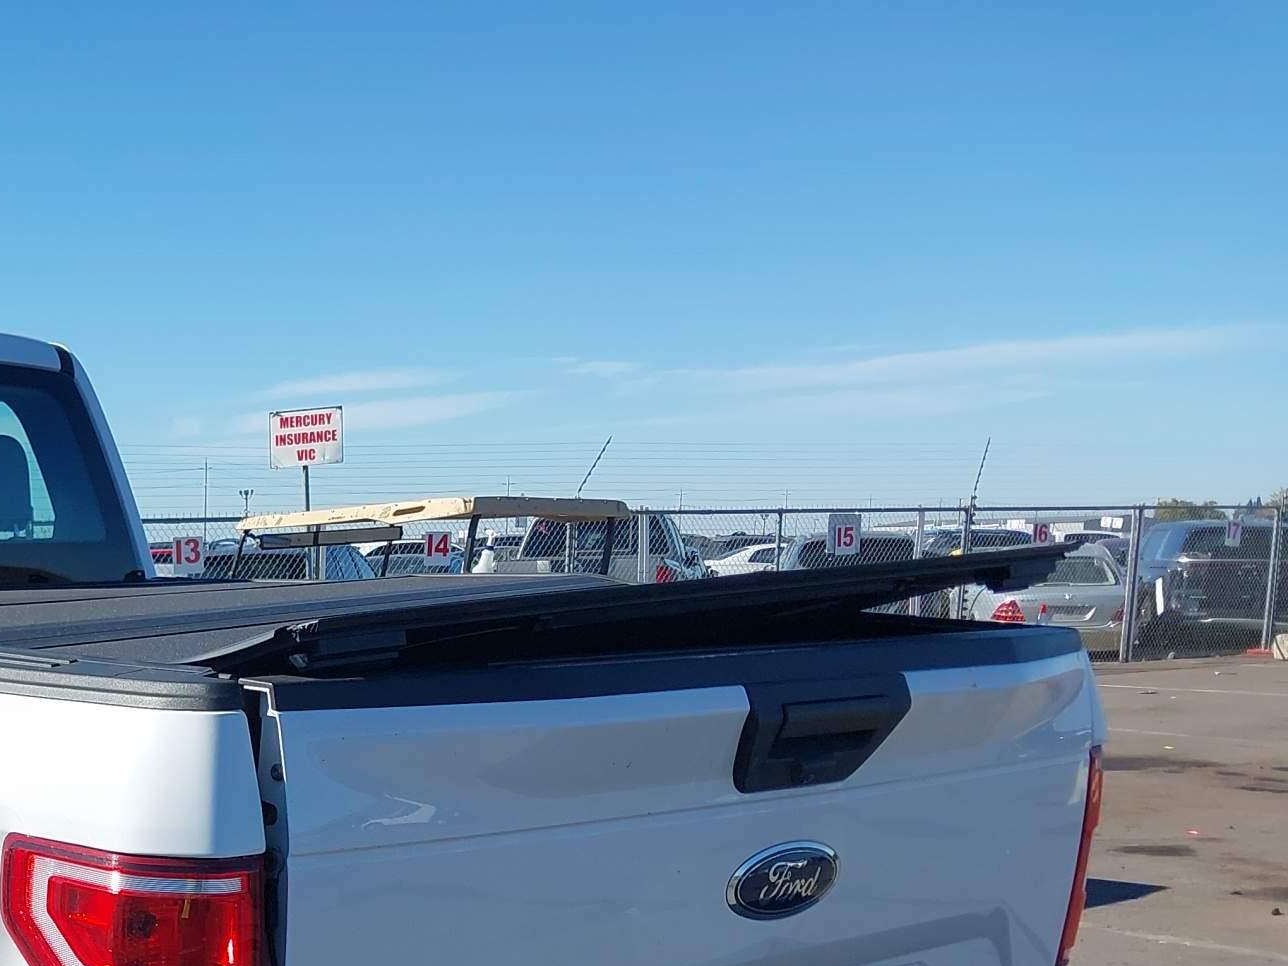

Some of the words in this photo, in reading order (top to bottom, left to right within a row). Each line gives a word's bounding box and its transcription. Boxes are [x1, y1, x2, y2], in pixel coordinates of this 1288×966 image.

[279, 412, 332, 429] MERCURY
[275, 429, 338, 447] INSURANCE
[296, 448, 316, 461] VIC
[837, 526, 854, 547] 15
[1033, 523, 1048, 543] 16
[1227, 521, 1241, 540] 17
[175, 538, 201, 565] 13
[426, 533, 449, 557] 14
[759, 859, 822, 901] Ford
